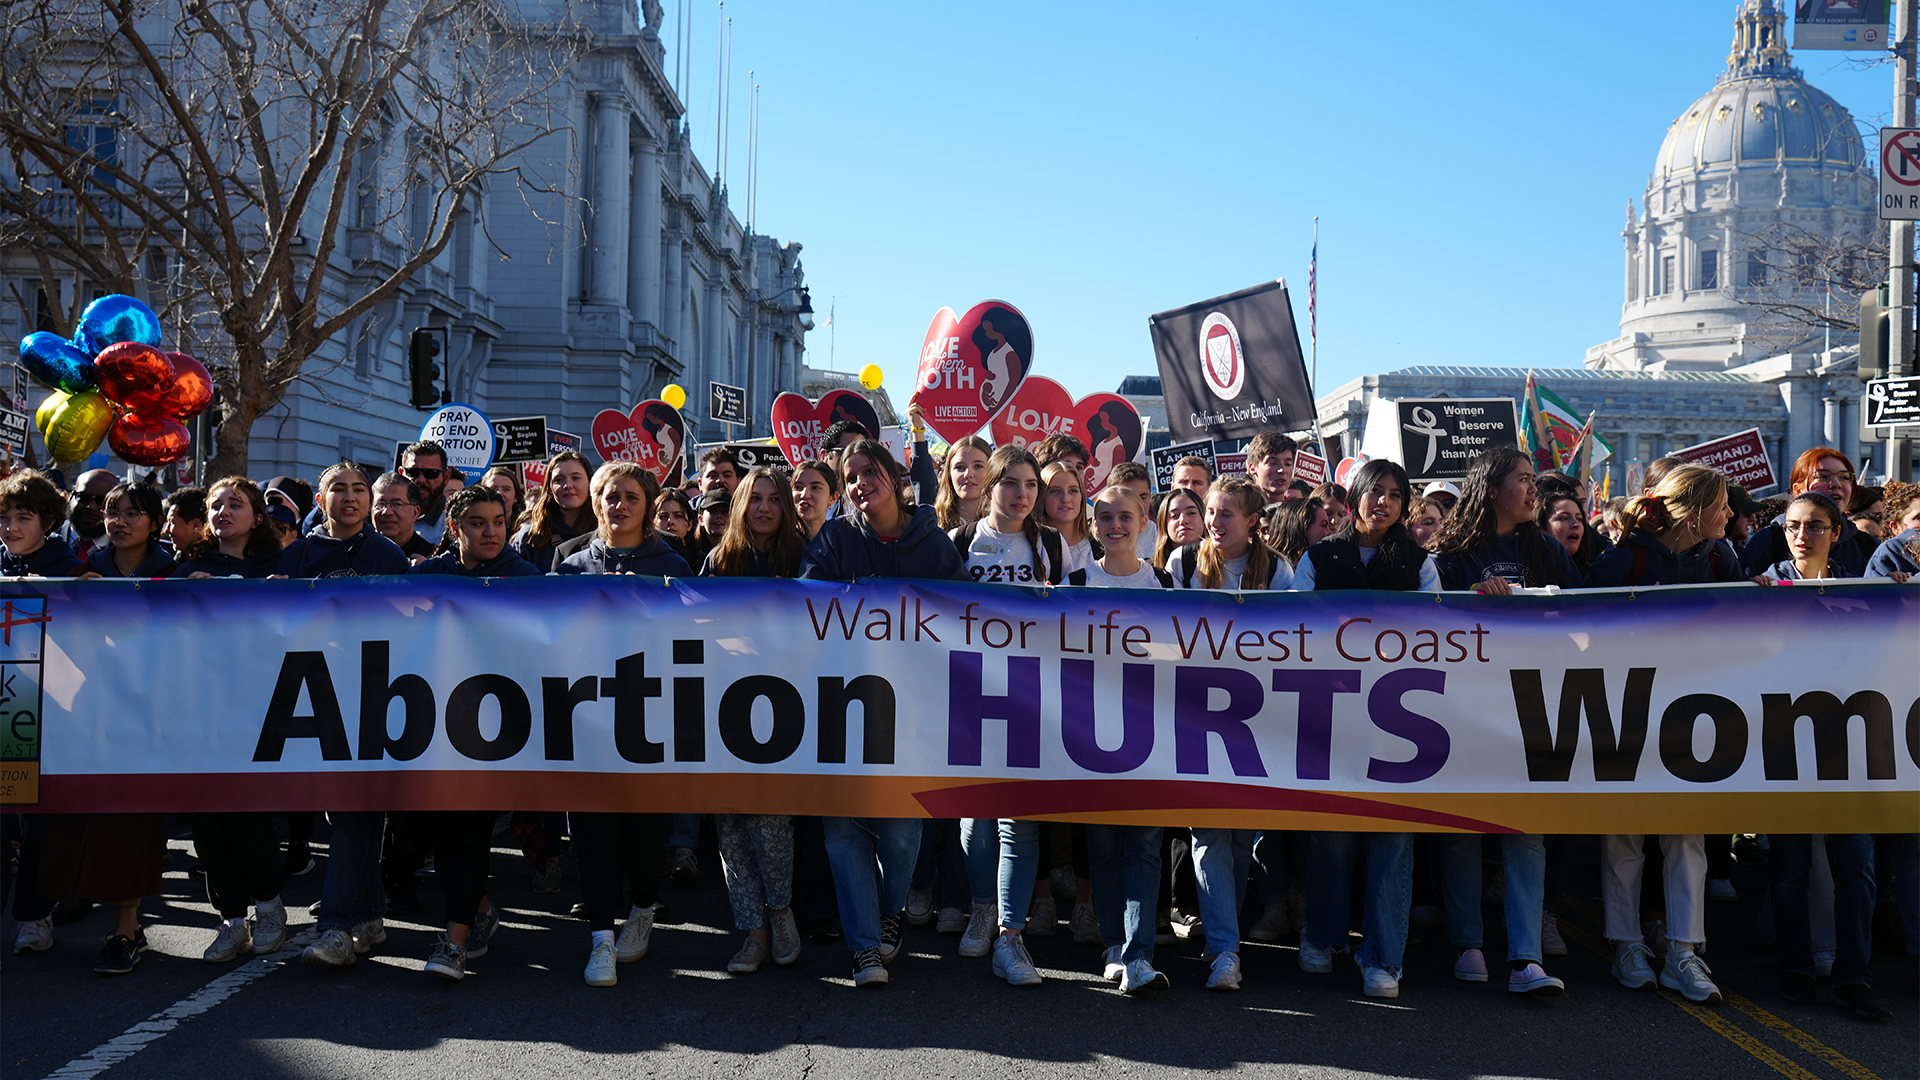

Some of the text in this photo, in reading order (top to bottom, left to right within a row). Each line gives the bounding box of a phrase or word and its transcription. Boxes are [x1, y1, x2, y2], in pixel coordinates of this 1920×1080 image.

[1884, 194, 1903, 209] ON
[920, 336, 960, 366] LOVE
[931, 352, 966, 370] them
[916, 367, 975, 393] BOTH
[438, 411, 473, 423] PRAY
[934, 405, 978, 417] LIVE ACTION
[1190, 410, 1226, 431] California
[1231, 406, 1251, 422] New
[1249, 398, 1283, 424] England
[1443, 405, 1485, 416] Women
[2, 413, 26, 431] AM
[1006, 404, 1075, 437] LOVE
[1458, 420, 1504, 431] Deserve
[430, 425, 479, 437] TO END
[780, 419, 823, 439] LOVE
[434, 438, 487, 451] ORTION
[554, 434, 573, 445] EVERY
[600, 427, 639, 448] LOVE
[799, 431, 820, 447] the
[1451, 435, 1487, 445] Better
[550, 442, 575, 453] PERSON
[610, 443, 654, 463] BOTH
[790, 444, 820, 463] BOT
[1441, 449, 1466, 459] than
[1692, 443, 1752, 466] DEMAND
[763, 453, 787, 461] Peac
[1166, 452, 1183, 464] AM
[1187, 447, 1209, 457] THE
[523, 461, 547, 476] OTH
[1221, 461, 1248, 471] DEMA
[1717, 453, 1767, 476] ECTION
[969, 564, 1046, 582] 9213
[805, 596, 1491, 663] Walk for Life West Coast
[252, 640, 897, 765] Abortion
[947, 649, 1451, 784] HURTS
[2, 744, 35, 756] AST
[1, 770, 32, 781] TION.
[0, 785, 17, 796] CE.
